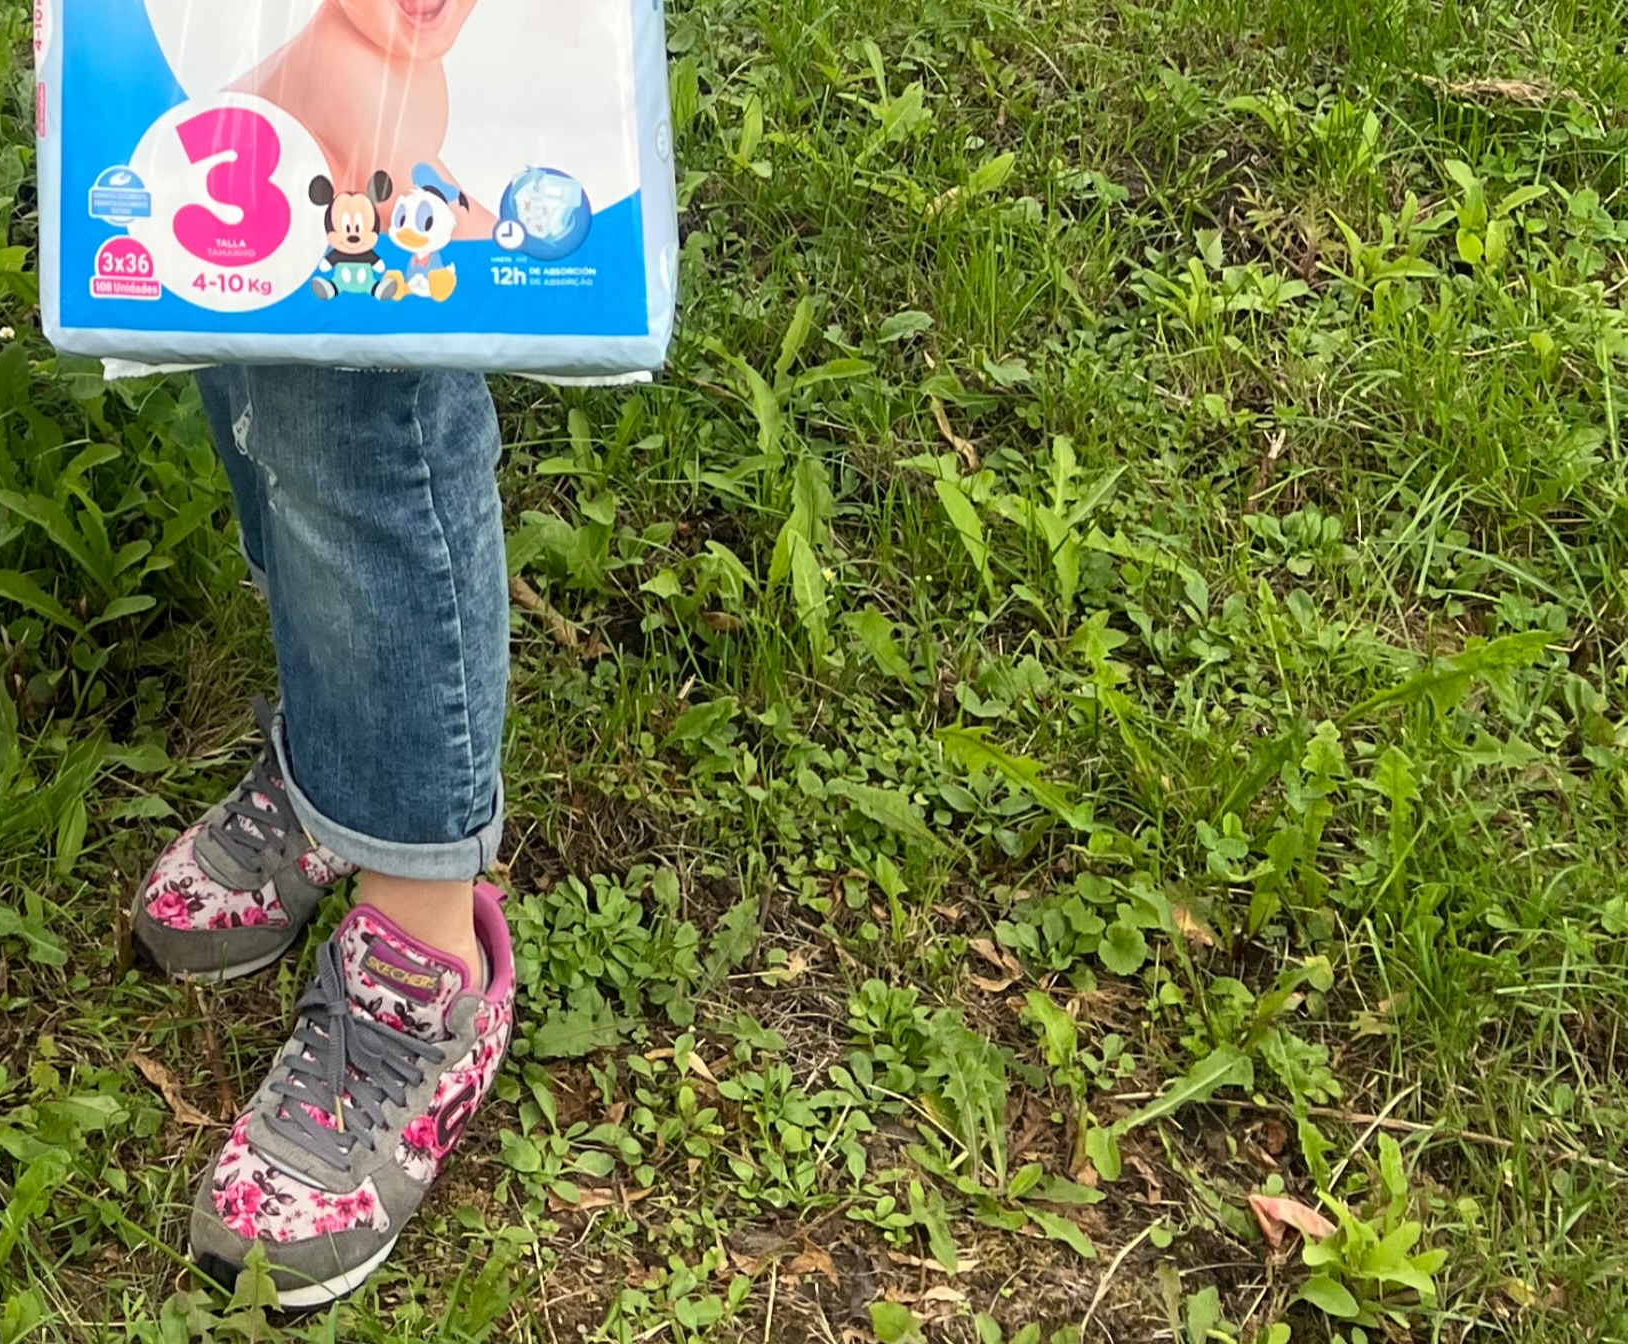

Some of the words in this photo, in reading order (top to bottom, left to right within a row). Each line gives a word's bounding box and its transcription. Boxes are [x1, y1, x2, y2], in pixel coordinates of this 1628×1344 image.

[173, 106, 292, 268] 3
[215, 238, 247, 248] TALLA
[102, 251, 150, 274] 3x36
[192, 274, 244, 293] 4-10
[248, 279, 272, 296] Kg
[490, 266, 527, 286] 12h
